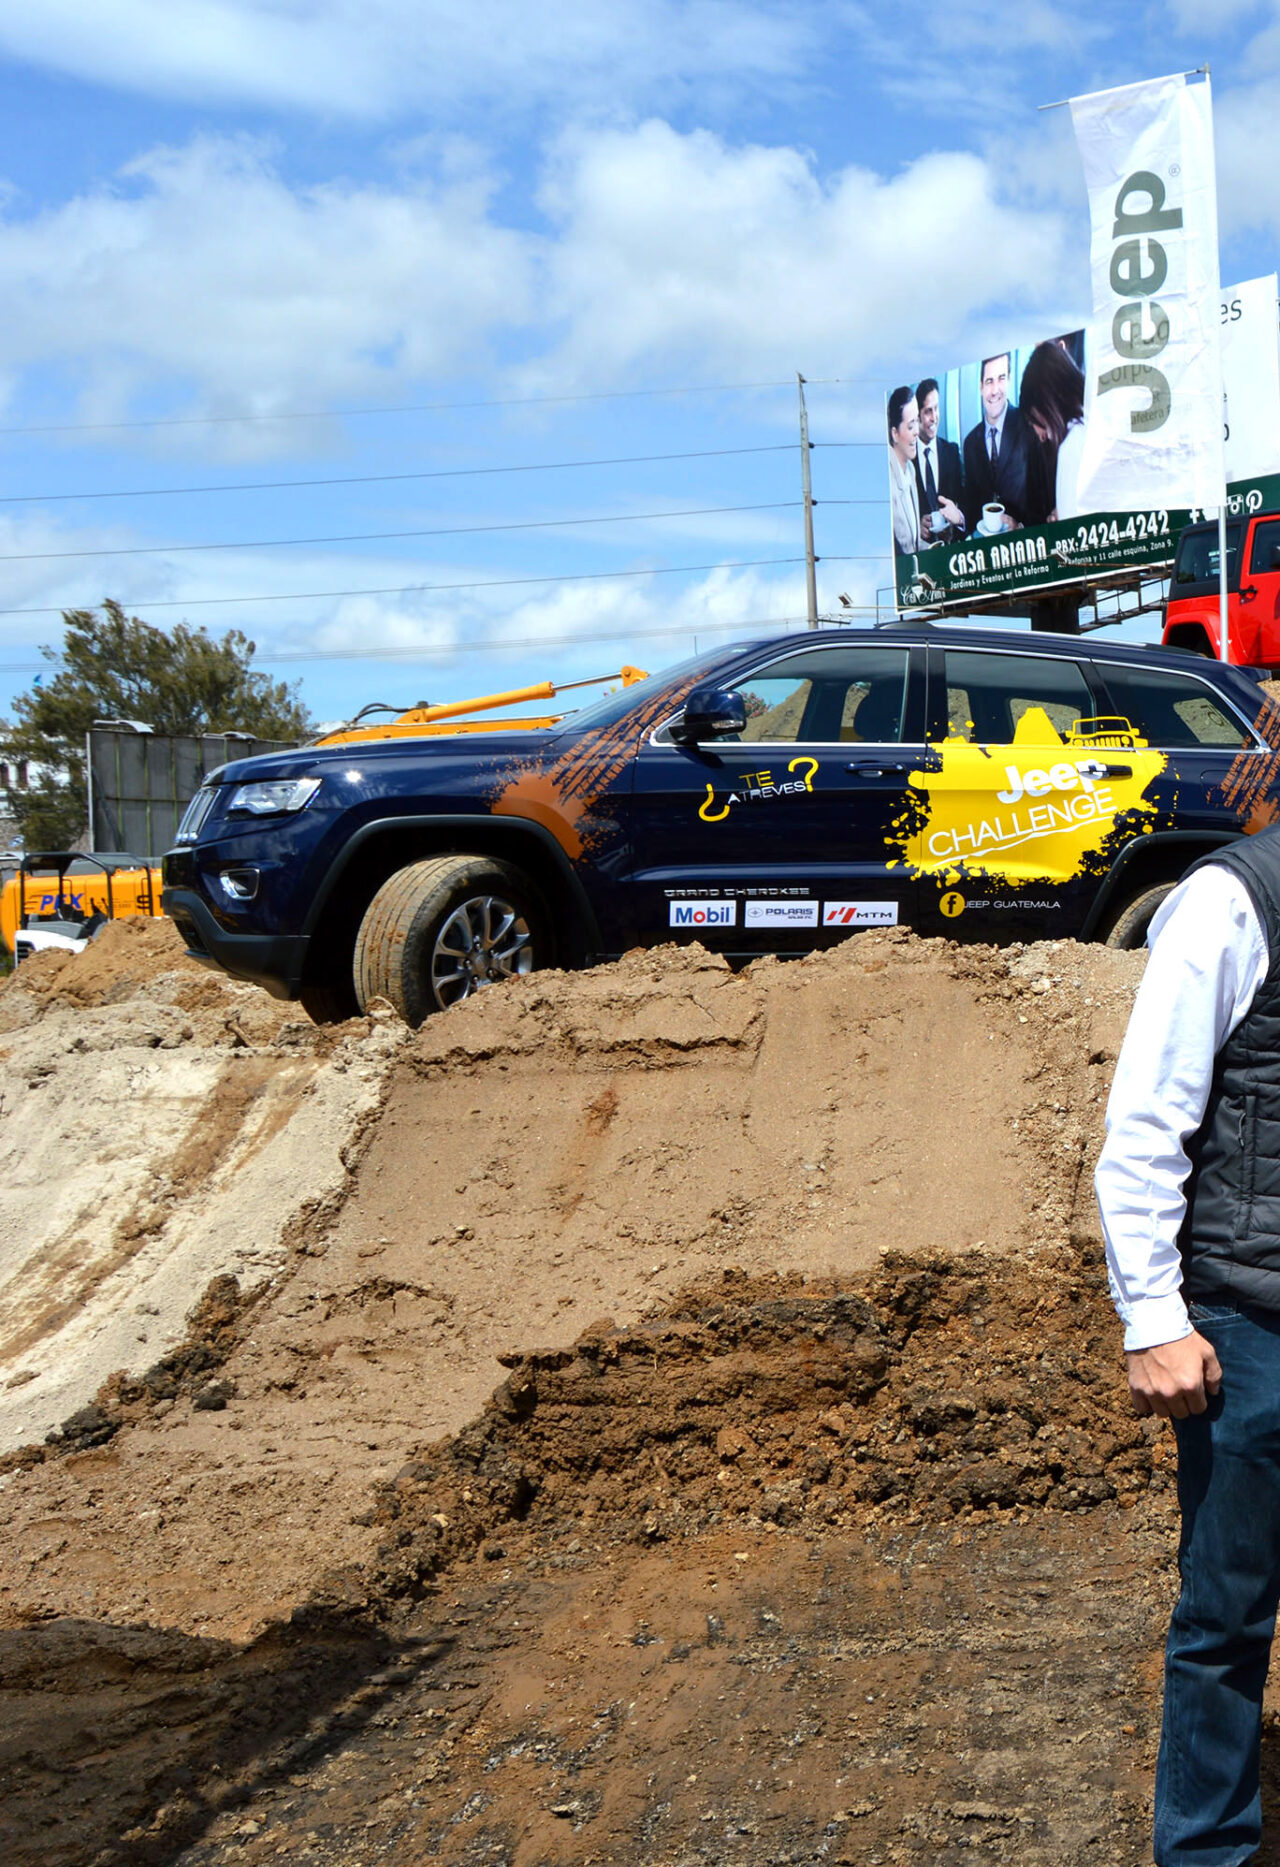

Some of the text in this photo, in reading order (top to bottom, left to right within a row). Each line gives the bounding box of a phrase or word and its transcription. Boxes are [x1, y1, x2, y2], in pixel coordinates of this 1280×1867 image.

[1097, 170, 1184, 433] Jeep
[1077, 509, 1170, 550] 2424-4242
[1150, 540, 1165, 551] Zona
[949, 536, 1047, 576] CASA ARIANA
[1014, 567, 1023, 578] La
[1023, 562, 1050, 576] Reforma
[738, 770, 775, 789] TE
[996, 758, 1107, 804] Jeep
[928, 787, 1118, 856] CHALLENGE
[663, 887, 811, 898] GRAND CHEROKEE
[765, 907, 814, 916] POLARIS
[993, 900, 1061, 909] GUATEMALA
[675, 906, 730, 924] Mobil
[856, 911, 893, 919] MTM
